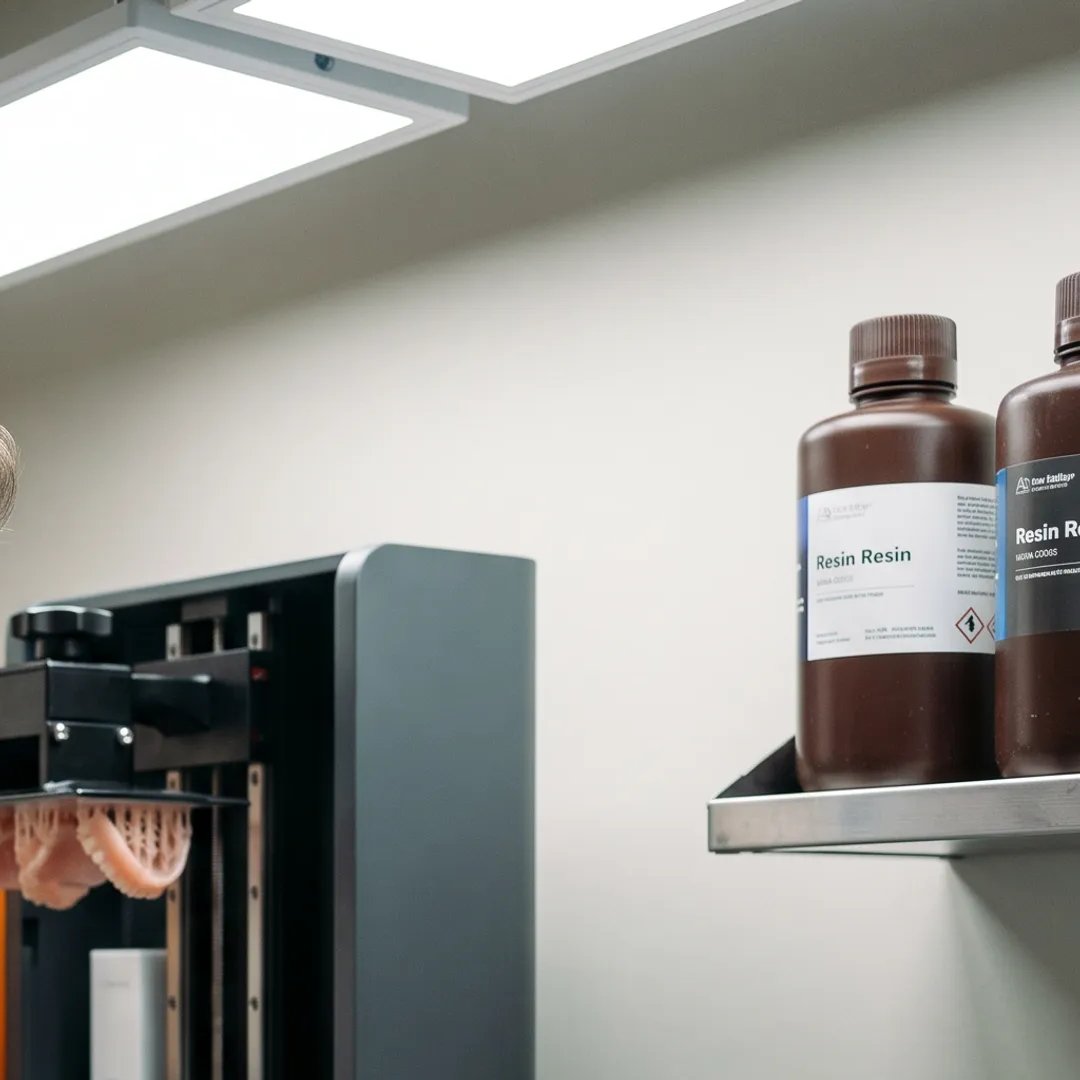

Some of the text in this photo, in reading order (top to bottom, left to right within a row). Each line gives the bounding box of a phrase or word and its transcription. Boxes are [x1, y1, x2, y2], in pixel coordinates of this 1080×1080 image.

[1016, 520, 1080, 545] Resin R
[816, 546, 911, 570] Resin Resin
